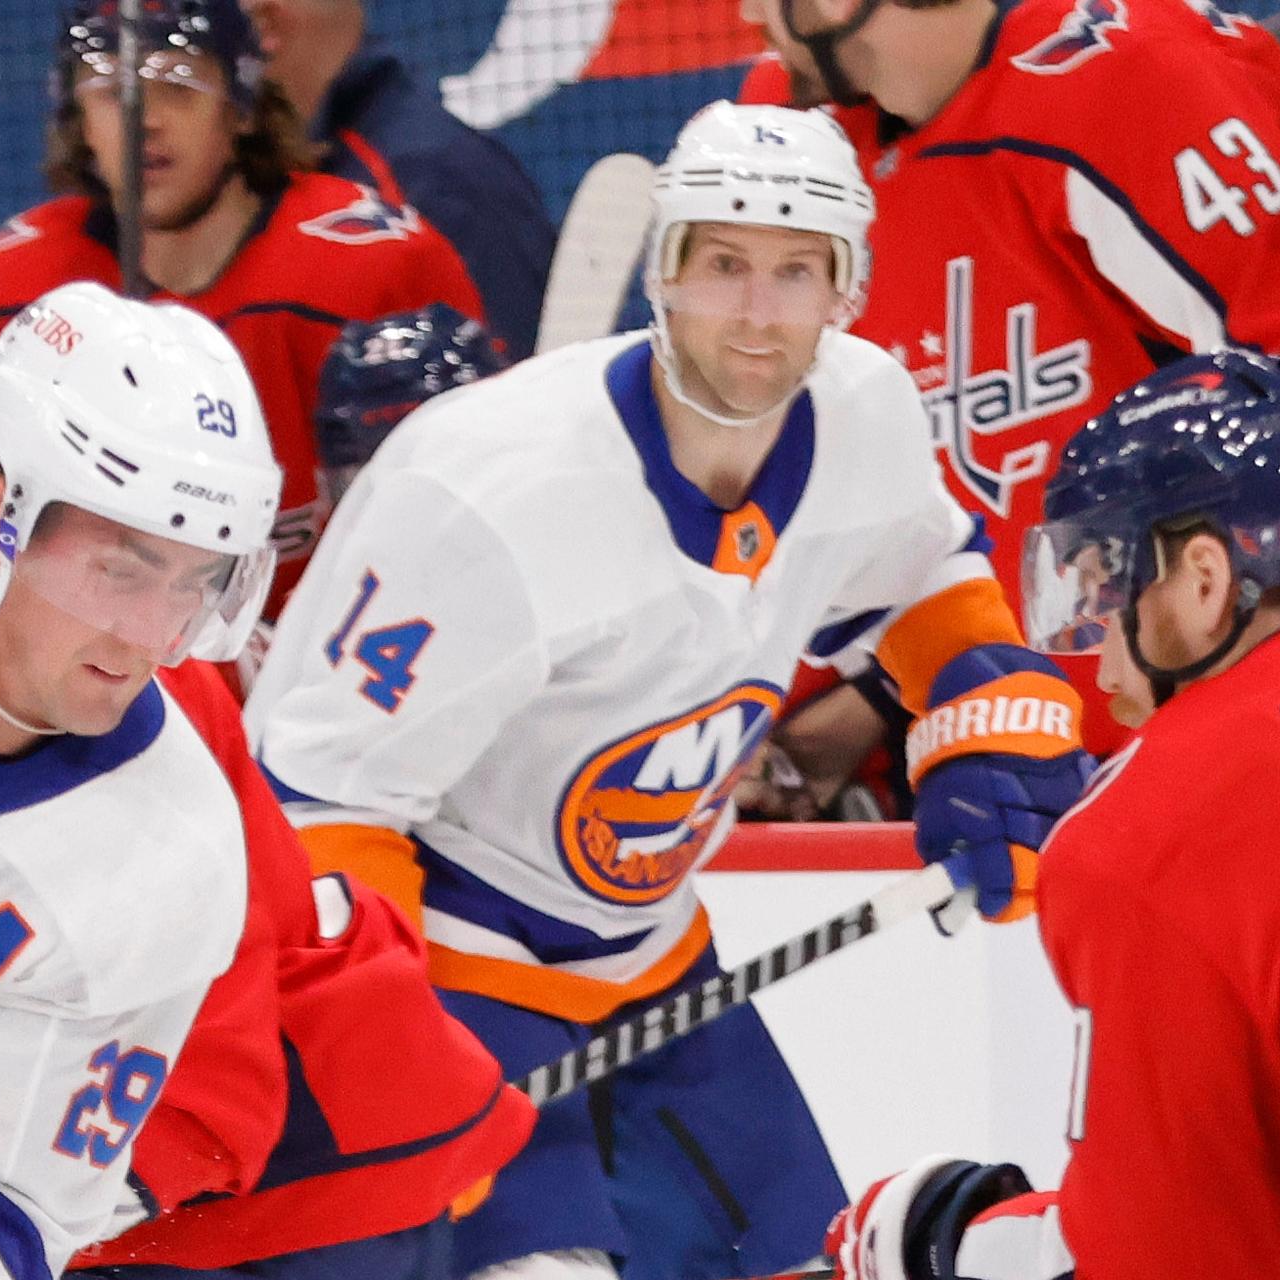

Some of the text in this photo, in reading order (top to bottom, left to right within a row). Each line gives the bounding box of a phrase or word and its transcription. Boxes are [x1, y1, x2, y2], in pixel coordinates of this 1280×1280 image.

[194, 393, 237, 438] 29
[323, 568, 435, 715] 14
[52, 1039, 168, 1170] 29
